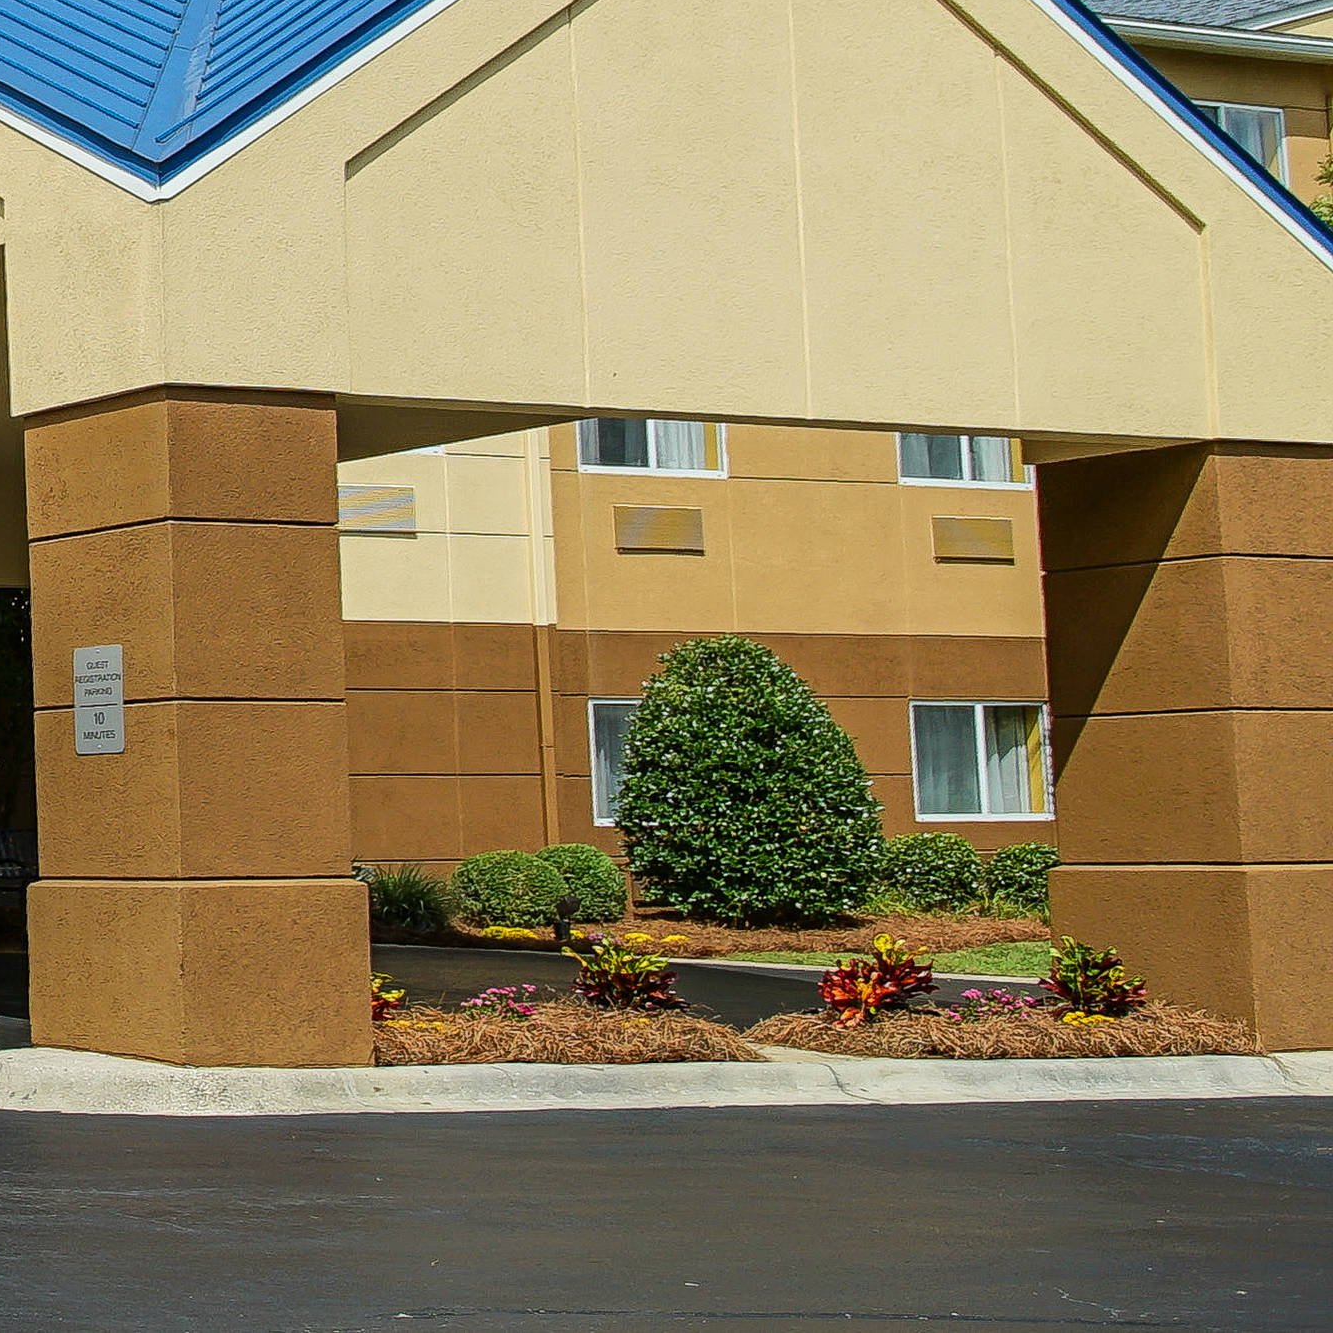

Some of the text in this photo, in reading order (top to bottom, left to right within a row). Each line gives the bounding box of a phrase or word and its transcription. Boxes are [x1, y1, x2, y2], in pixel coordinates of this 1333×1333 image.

[86, 660, 109, 670] GUEST
[93, 711, 105, 725] 10
[83, 730, 116, 740] MINUTES
